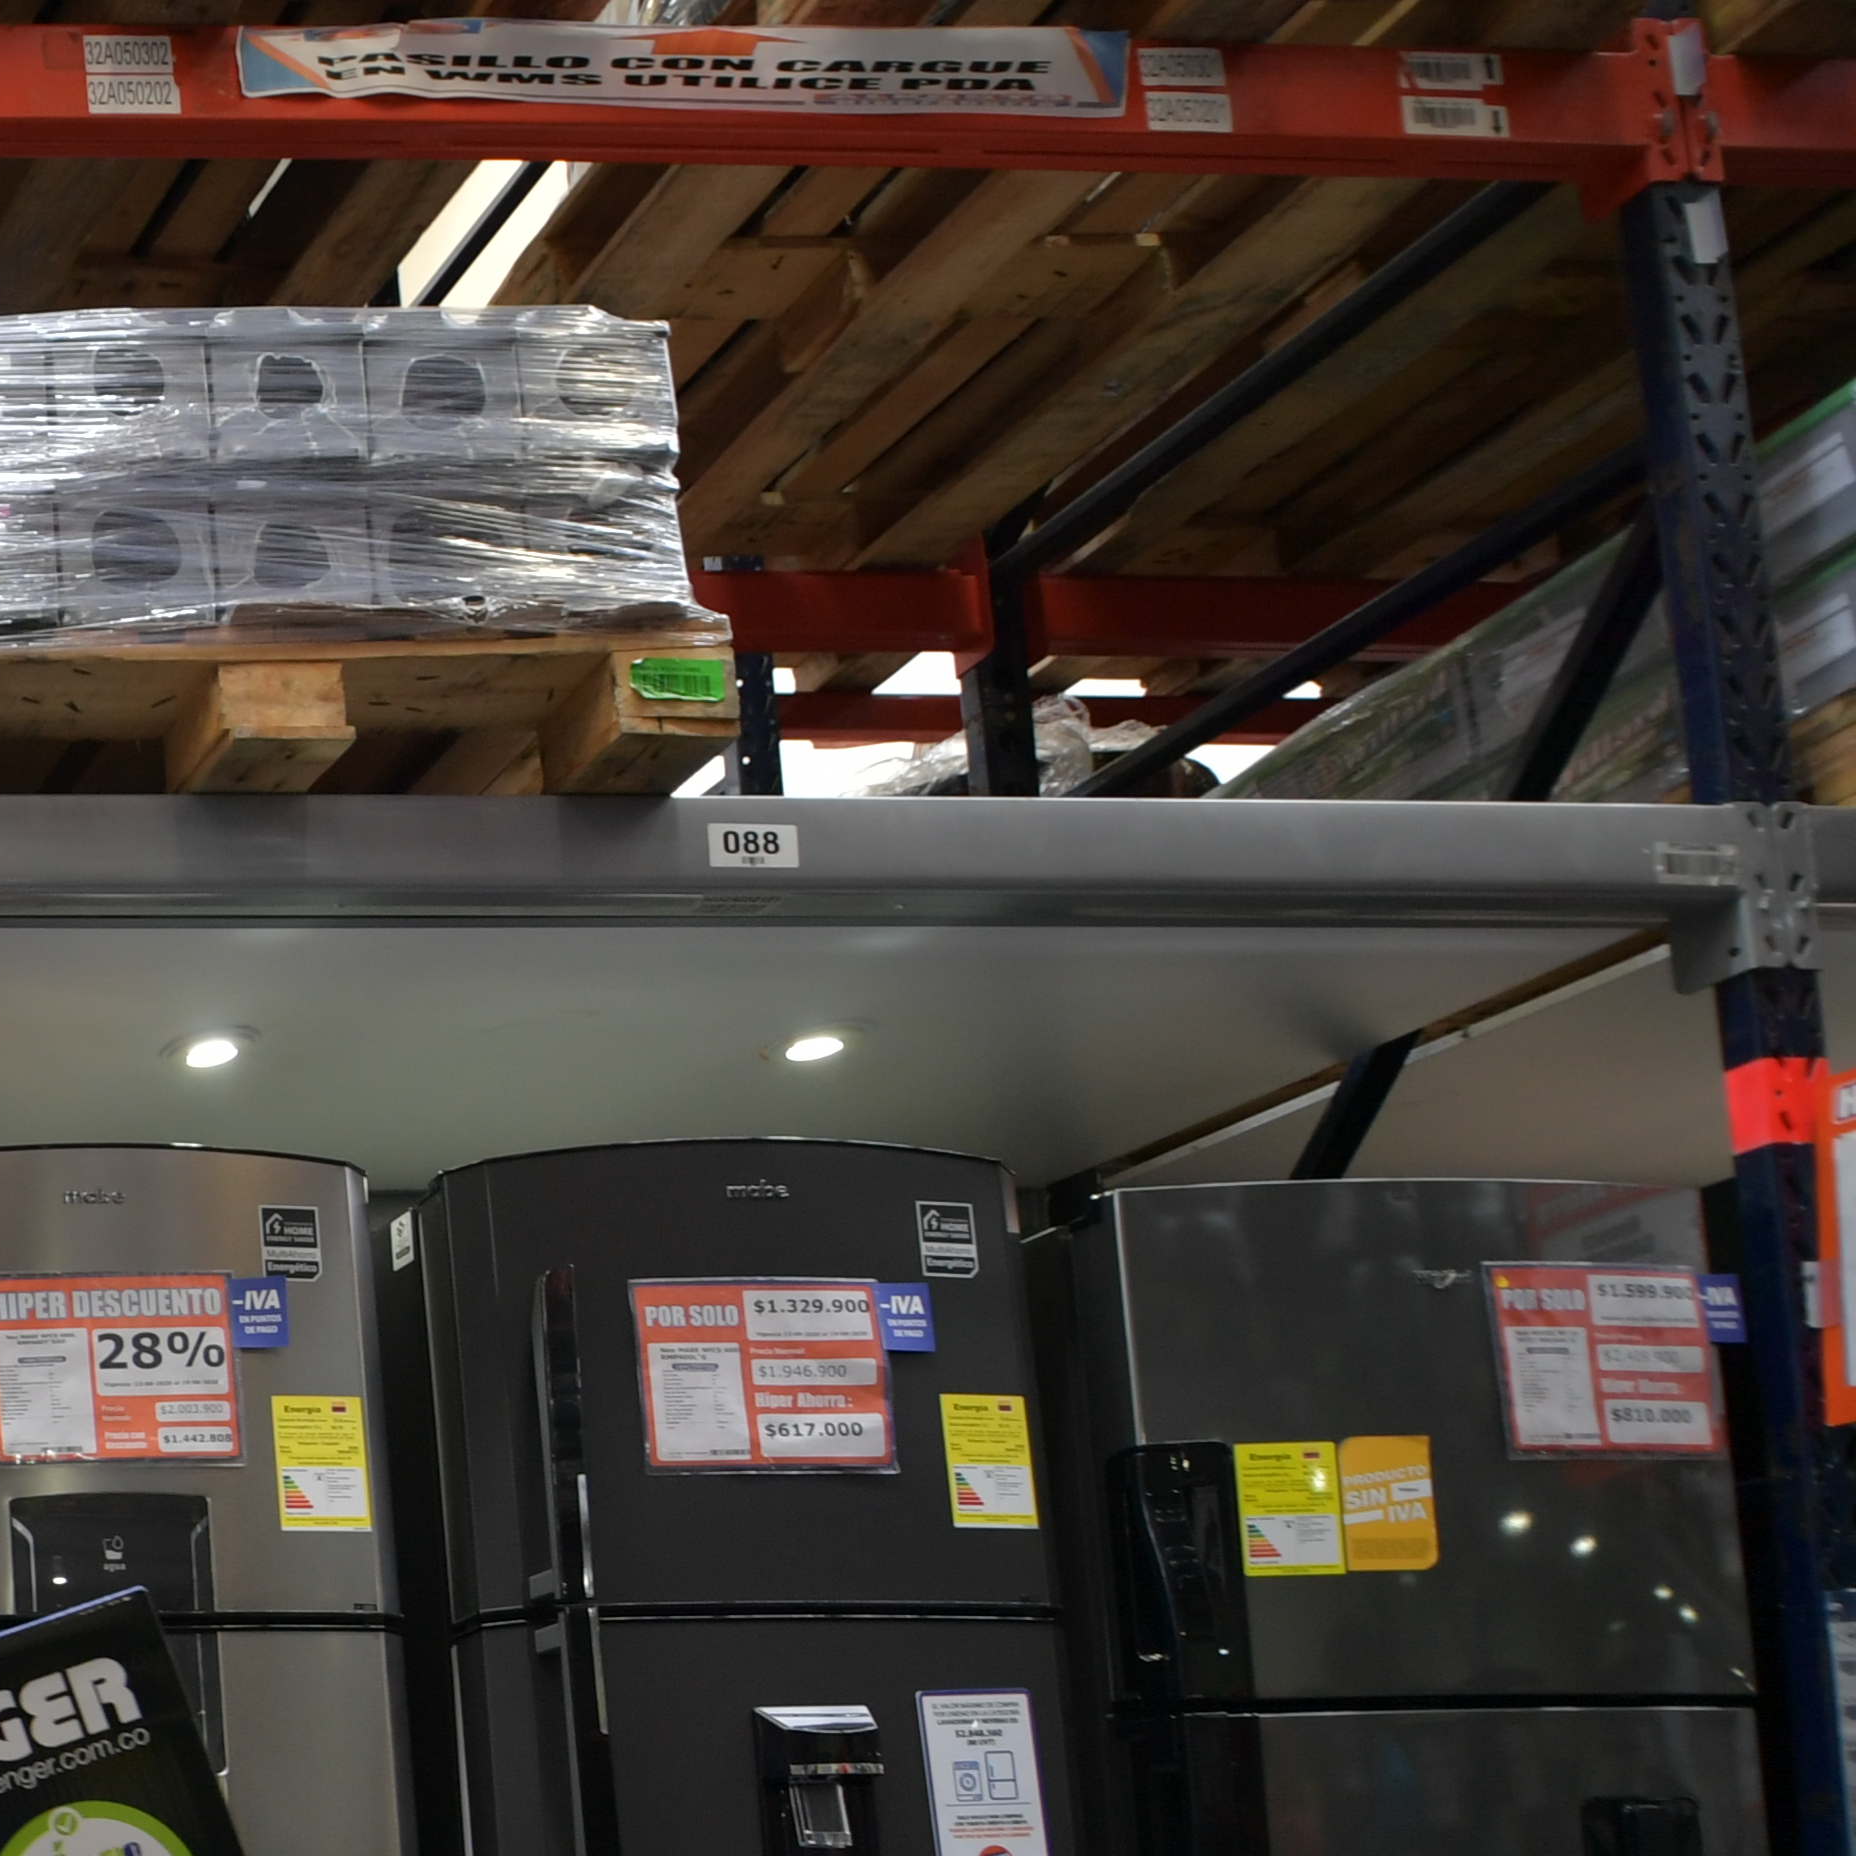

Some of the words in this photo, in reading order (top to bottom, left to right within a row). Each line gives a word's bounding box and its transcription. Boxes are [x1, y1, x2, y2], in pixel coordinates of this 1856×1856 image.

[85, 41, 169, 66] 32A050302
[317, 52, 590, 69] PASILLO
[611, 55, 755, 74] CON
[763, 58, 1051, 76] CARGUE
[325, 66, 406, 80] EN
[427, 70, 603, 86] WMS
[623, 73, 893, 92] UTILICE
[901, 78, 1036, 92] PDA
[88, 80, 172, 105] 32A050202
[723, 830, 780, 854] 088
[61, 1188, 126, 1206] mabe
[725, 1180, 790, 1200] mabe
[283, 1226, 314, 1235] HOME
[267, 1262, 317, 1274] Energético
[72, 1287, 222, 1318] DESCUENTO
[232, 1289, 280, 1311] -IVA
[879, 1295, 925, 1315] -IVA
[644, 1305, 686, 1327] POR
[689, 1305, 739, 1327] SOLO
[753, 1299, 869, 1314] $1.329.900
[97, 1332, 225, 1370] 28%
[758, 1365, 847, 1378] $1.946.900
[160, 1405, 223, 1415] $2.003.900
[283, 1404, 322, 1416] Energía
[1611, 1408, 1692, 1424] $810.000
[163, 1433, 233, 1444] $1.442.808
[765, 1422, 863, 1437] $617.000
[1342, 1464, 1427, 1486] PRODUCTO
[1346, 1487, 1386, 1509] SIN
[1388, 1503, 1426, 1523] IVA
